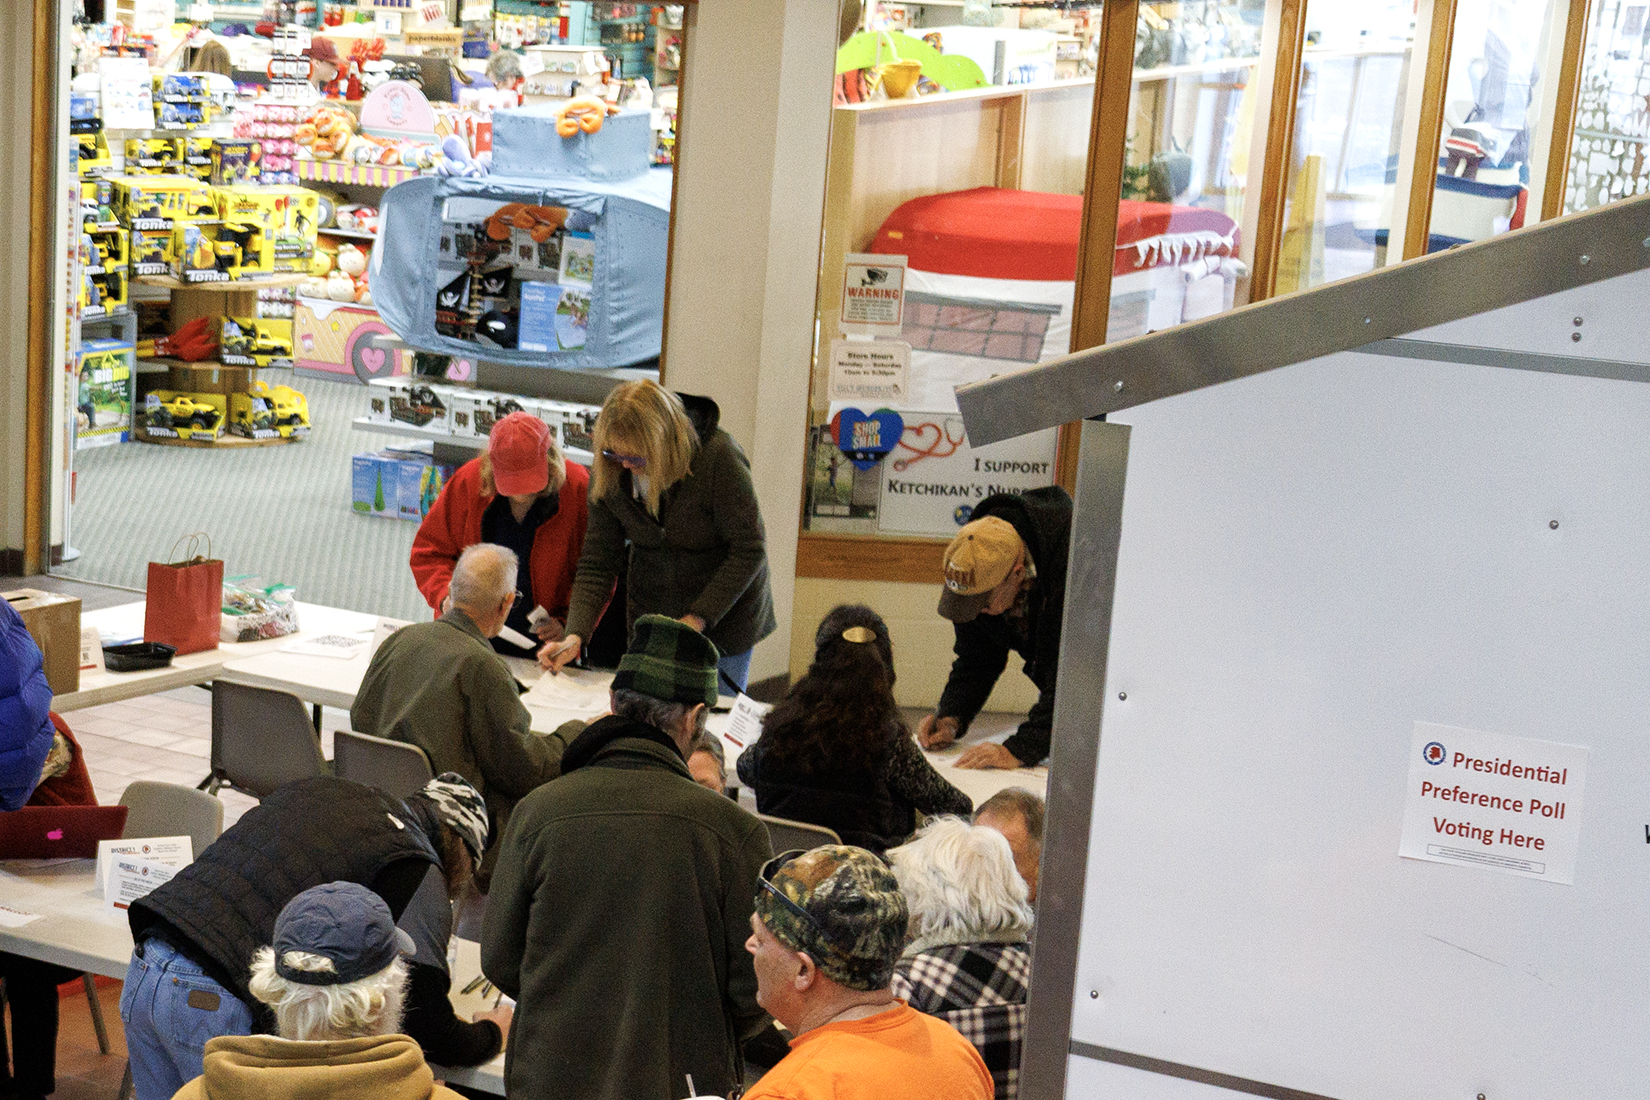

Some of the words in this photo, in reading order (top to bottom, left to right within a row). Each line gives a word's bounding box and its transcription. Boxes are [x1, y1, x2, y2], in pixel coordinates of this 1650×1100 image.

[131, 217, 173, 230] Tonka
[134, 262, 169, 274] Tonk
[185, 269, 230, 282] Tonka
[847, 287, 899, 300] WARNING
[222, 354, 256, 365] Tonka
[853, 420, 881, 436] SHOP
[852, 434, 882, 450] SMALL
[974, 458, 980, 472] I
[984, 460, 1050, 474] SUPPORT
[888, 479, 983, 498] KETCHIKAN'S
[1452, 751, 1568, 785] Presidential
[1420, 781, 1524, 812] Preference
[1529, 799, 1566, 820] Poll
[1432, 816, 1494, 846] Voting
[1499, 828, 1546, 851] Here
